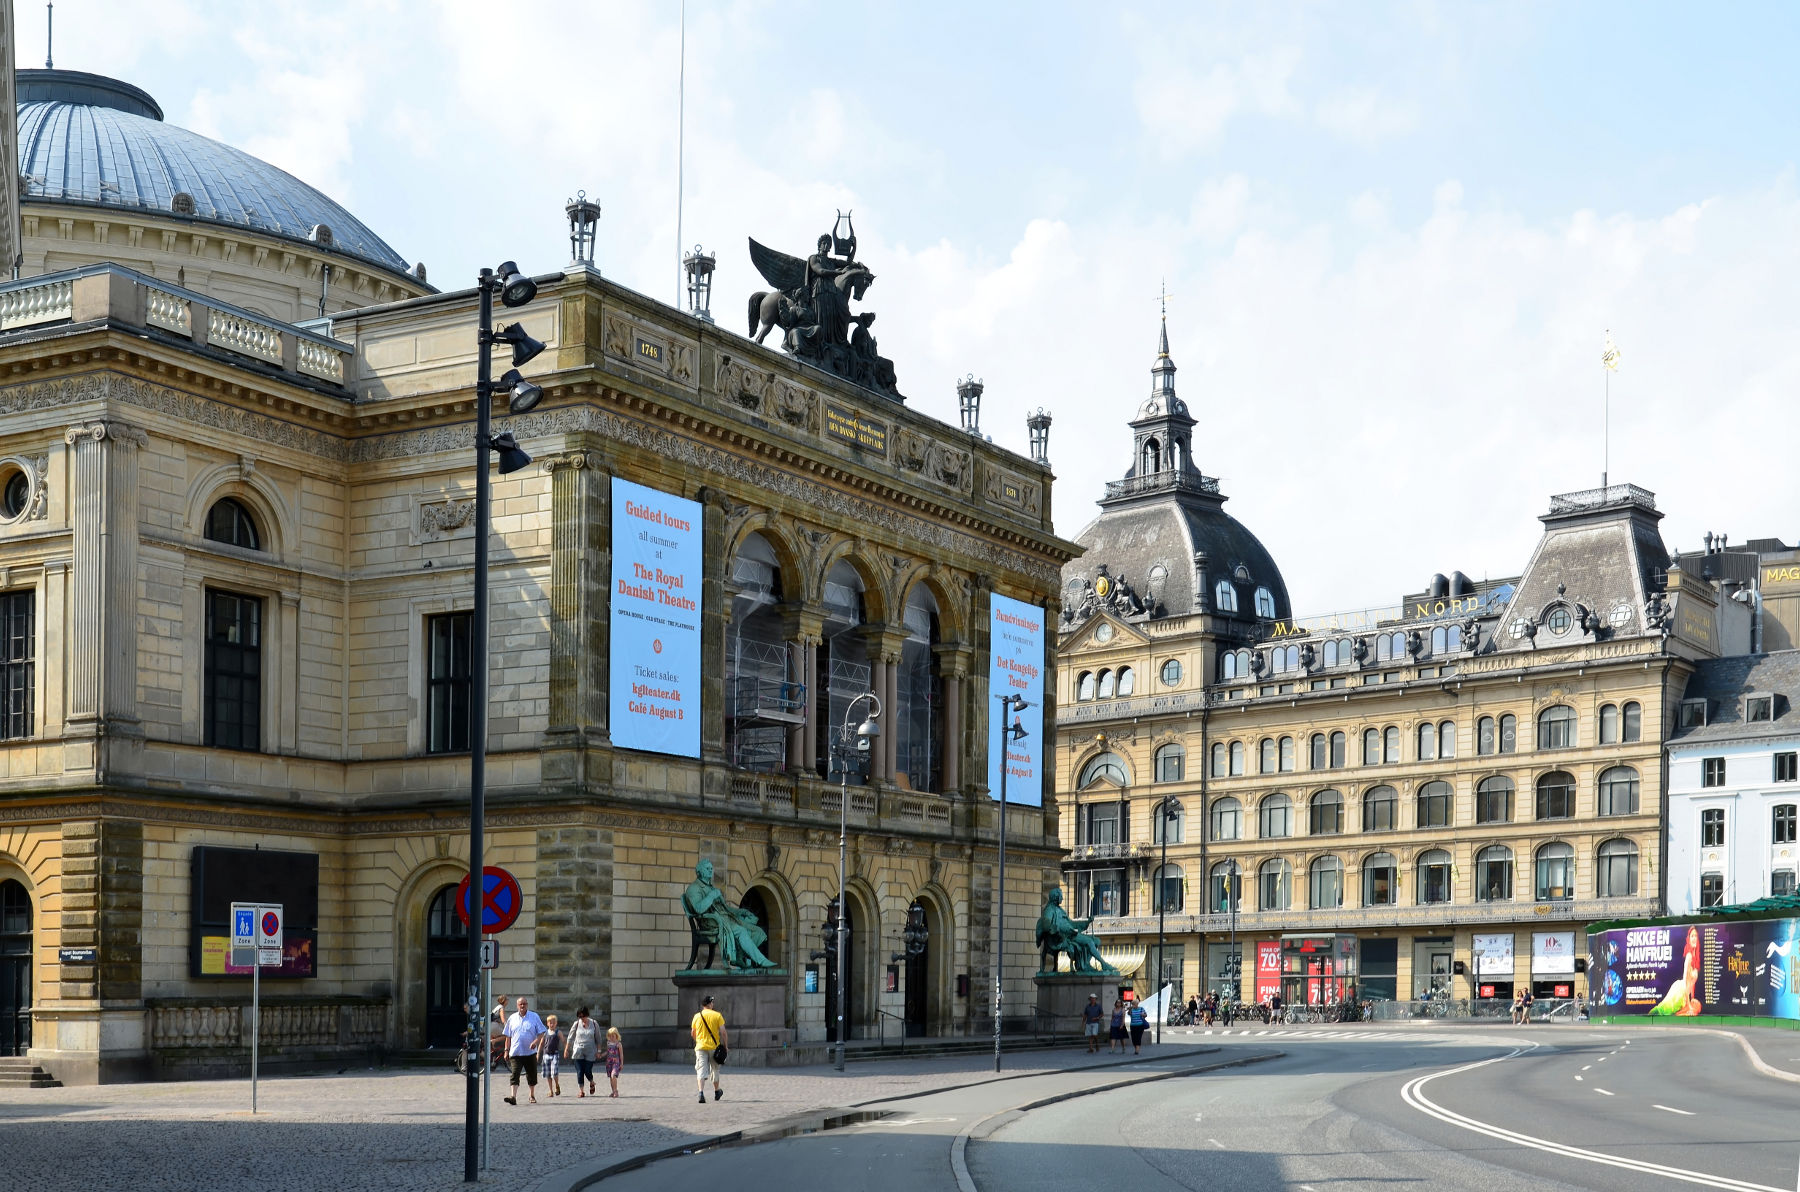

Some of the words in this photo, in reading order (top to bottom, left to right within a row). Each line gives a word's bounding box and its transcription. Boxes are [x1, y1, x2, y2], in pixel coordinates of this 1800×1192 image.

[641, 343, 658, 358] 1748
[626, 501, 662, 524] Guided
[664, 513, 690, 532] tours
[639, 531, 648, 542] all
[650, 536, 678, 550] summer
[656, 550, 662, 560] at
[634, 563, 653, 581] The
[656, 568, 684, 590] Royal
[618, 580, 655, 602] Danish
[658, 589, 696, 611] Theatre
[618, 609, 631, 617] OPERA
[1415, 597, 1479, 619] NORD
[635, 665, 657, 679] Ticket
[659, 671, 679, 683] sales:
[997, 655, 1008, 669] Det
[1009, 658, 1038, 680] Kongelige
[632, 682, 681, 702] kglteater.dk
[628, 700, 647, 714] Café
[649, 704, 677, 720] August
[678, 709, 684, 720] B
[1626, 931, 1656, 948] SIKKE
[1657, 929, 1670, 946] EN
[1626, 946, 1672, 963] HAVFRUE!
